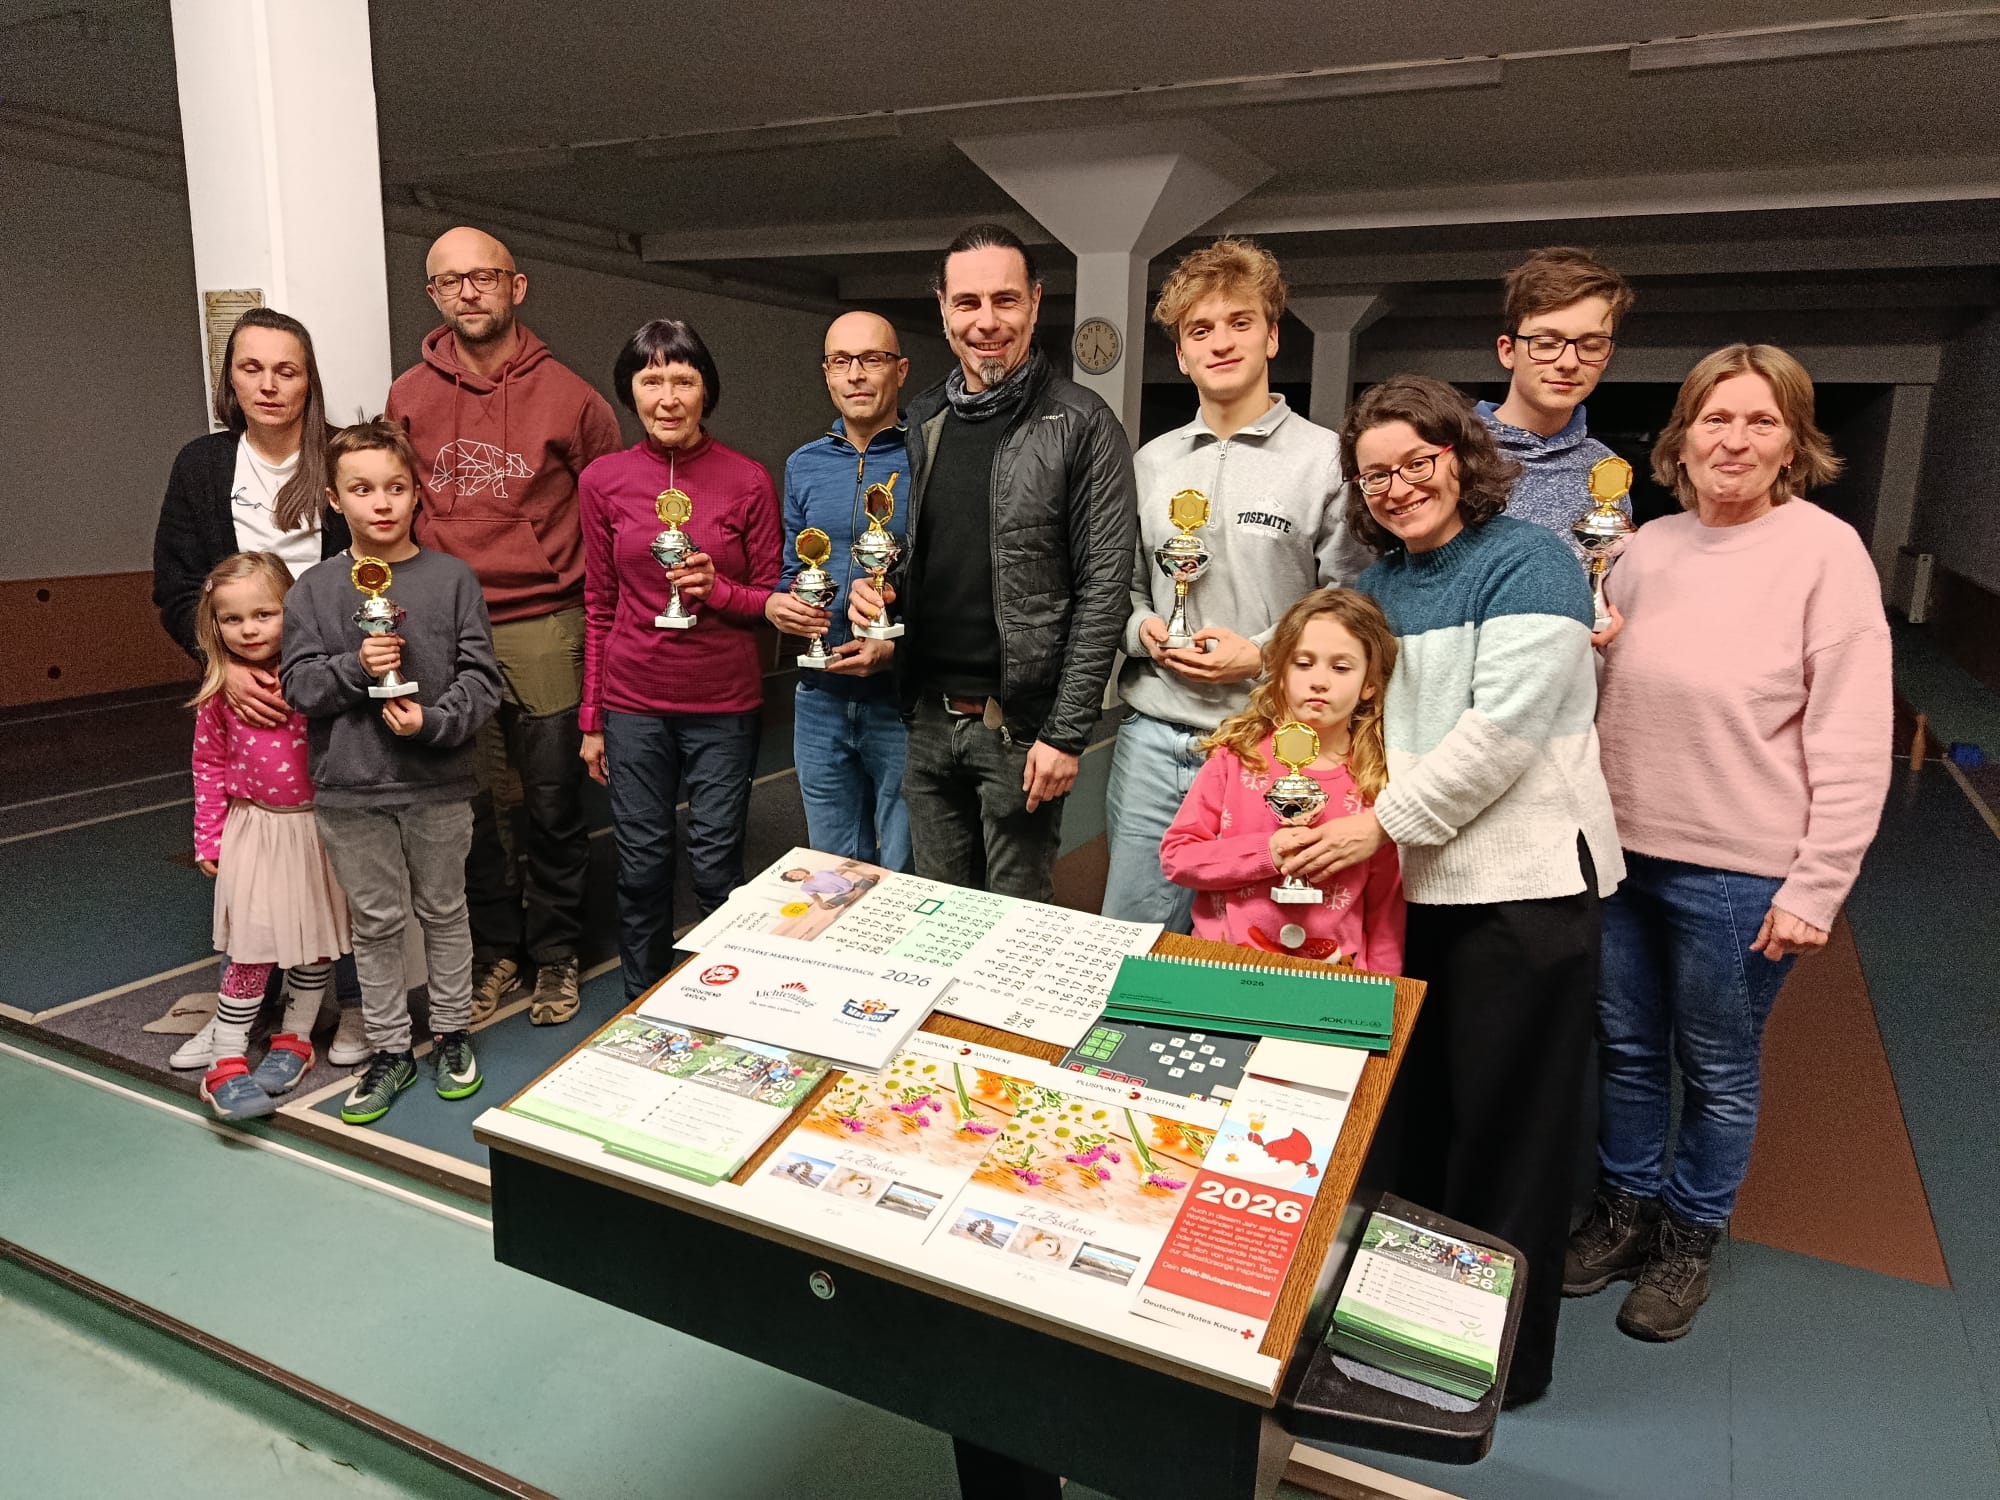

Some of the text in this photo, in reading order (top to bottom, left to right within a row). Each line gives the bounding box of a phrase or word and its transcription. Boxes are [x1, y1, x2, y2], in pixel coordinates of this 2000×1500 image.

[1237, 512, 1292, 533] YOSEMITE
[995, 962, 1008, 971] 10
[1016, 941, 1029, 949] 12
[998, 934, 1052, 985] 16 17 18 19 20
[1010, 936, 1064, 990] 23 24 25 26 27
[801, 958, 827, 966] UNTER
[827, 963, 852, 972] EINEM
[852, 968, 874, 976] DACH
[1049, 926, 1128, 1014] 12 16 17 18 19 20 22
[1073, 928, 1142, 1006] 23 24 25 26 27 29
[880, 970, 932, 988] 2026
[1035, 1002, 1048, 1010] 11
[1056, 978, 1069, 986] 10
[1065, 966, 1079, 975] 11
[1075, 954, 1089, 963] 12
[1084, 944, 1098, 952] 13
[1021, 998, 1034, 1006] 10
[846, 1006, 886, 1021] Margon
[1004, 1012, 1022, 1026] Mar
[670, 1050, 694, 1063] 20
[974, 1051, 1011, 1064] APOTHEKE
[657, 1060, 682, 1073] 26
[771, 1077, 796, 1091] 20
[759, 1089, 785, 1103] 26
[1076, 1080, 1186, 1110] PLUSPUNKT APOTHEKE
[1195, 1180, 1303, 1224] 2026
[1038, 1210, 1096, 1236] Balance
[1216, 1214, 1241, 1224] diesem
[1235, 1234, 1262, 1246] gesund
[1264, 1242, 1279, 1250] und
[1162, 1261, 1180, 1272] Dein
[1470, 1262, 1496, 1278] 20
[1466, 1274, 1494, 1290] 26
[1143, 1298, 1238, 1334] Deutsches Rotes Kreuz
